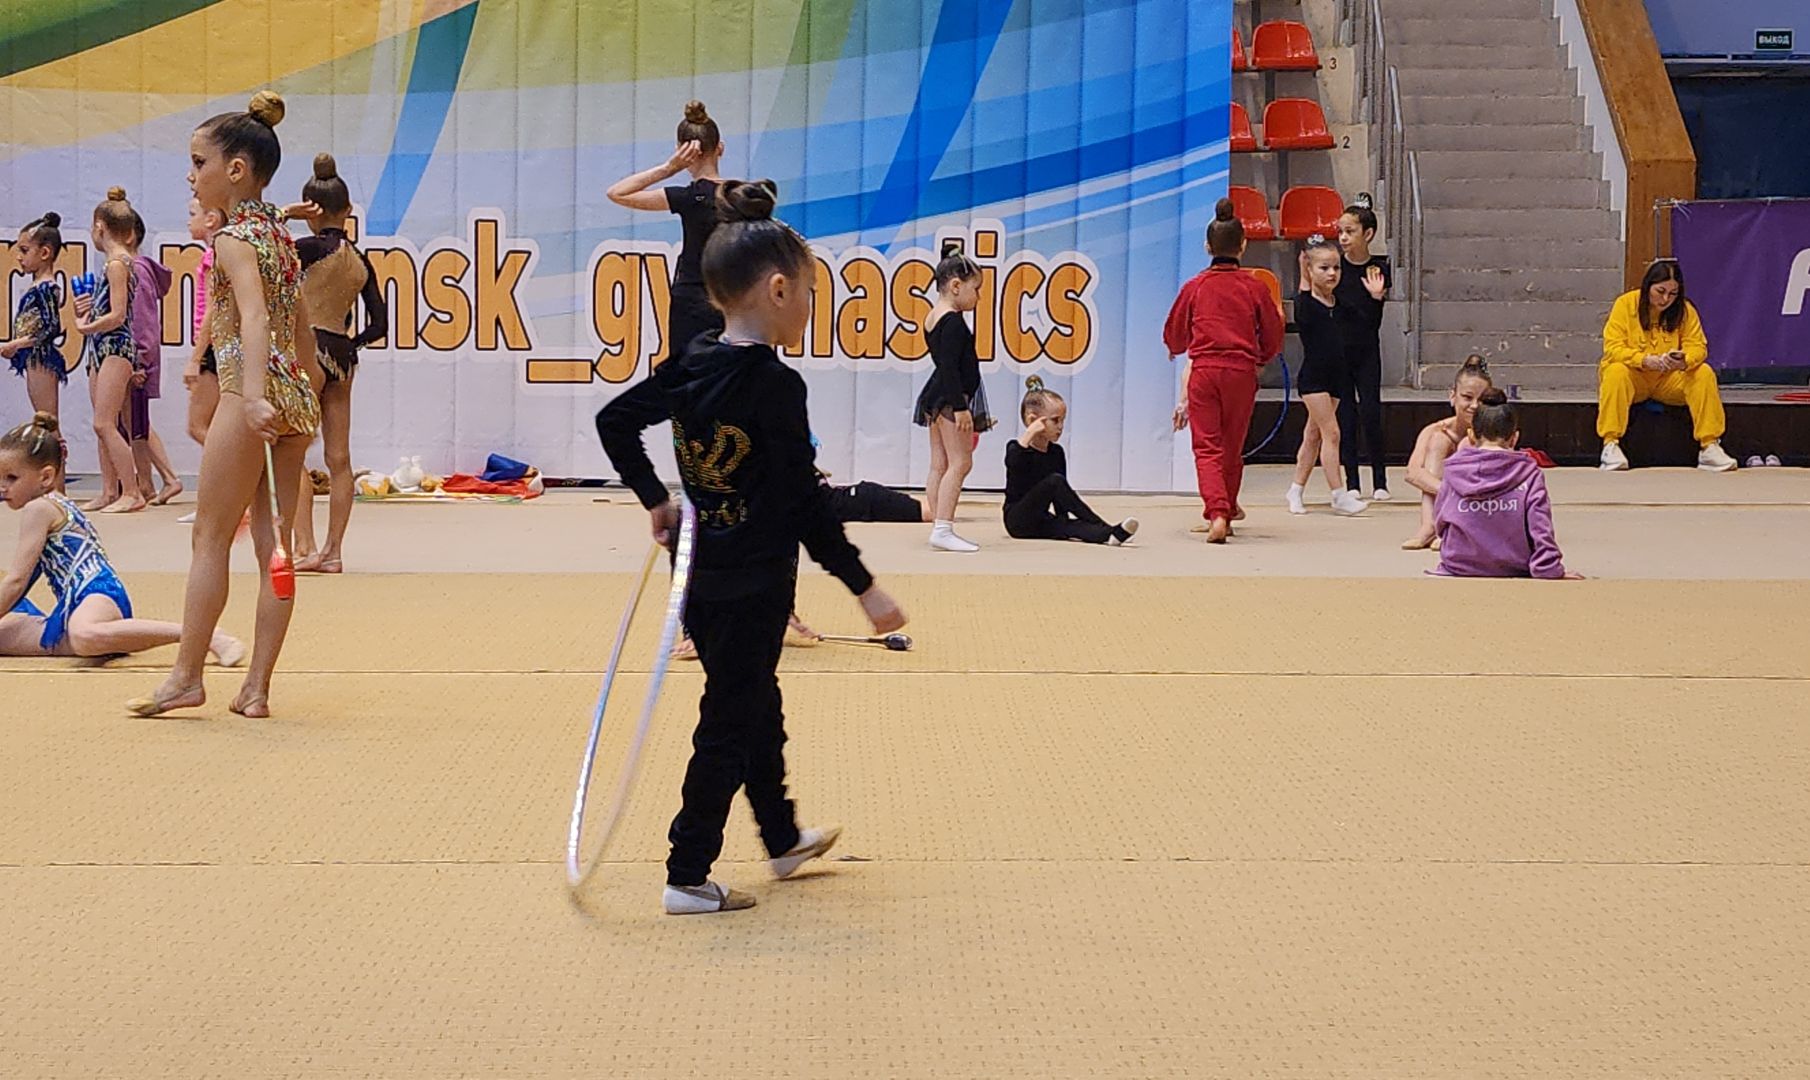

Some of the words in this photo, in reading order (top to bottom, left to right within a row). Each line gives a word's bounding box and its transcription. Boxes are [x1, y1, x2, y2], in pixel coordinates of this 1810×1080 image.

[1329, 57, 1337, 70] 3
[1342, 135, 1351, 149] 2
[1457, 498, 1518, 515] Софья
